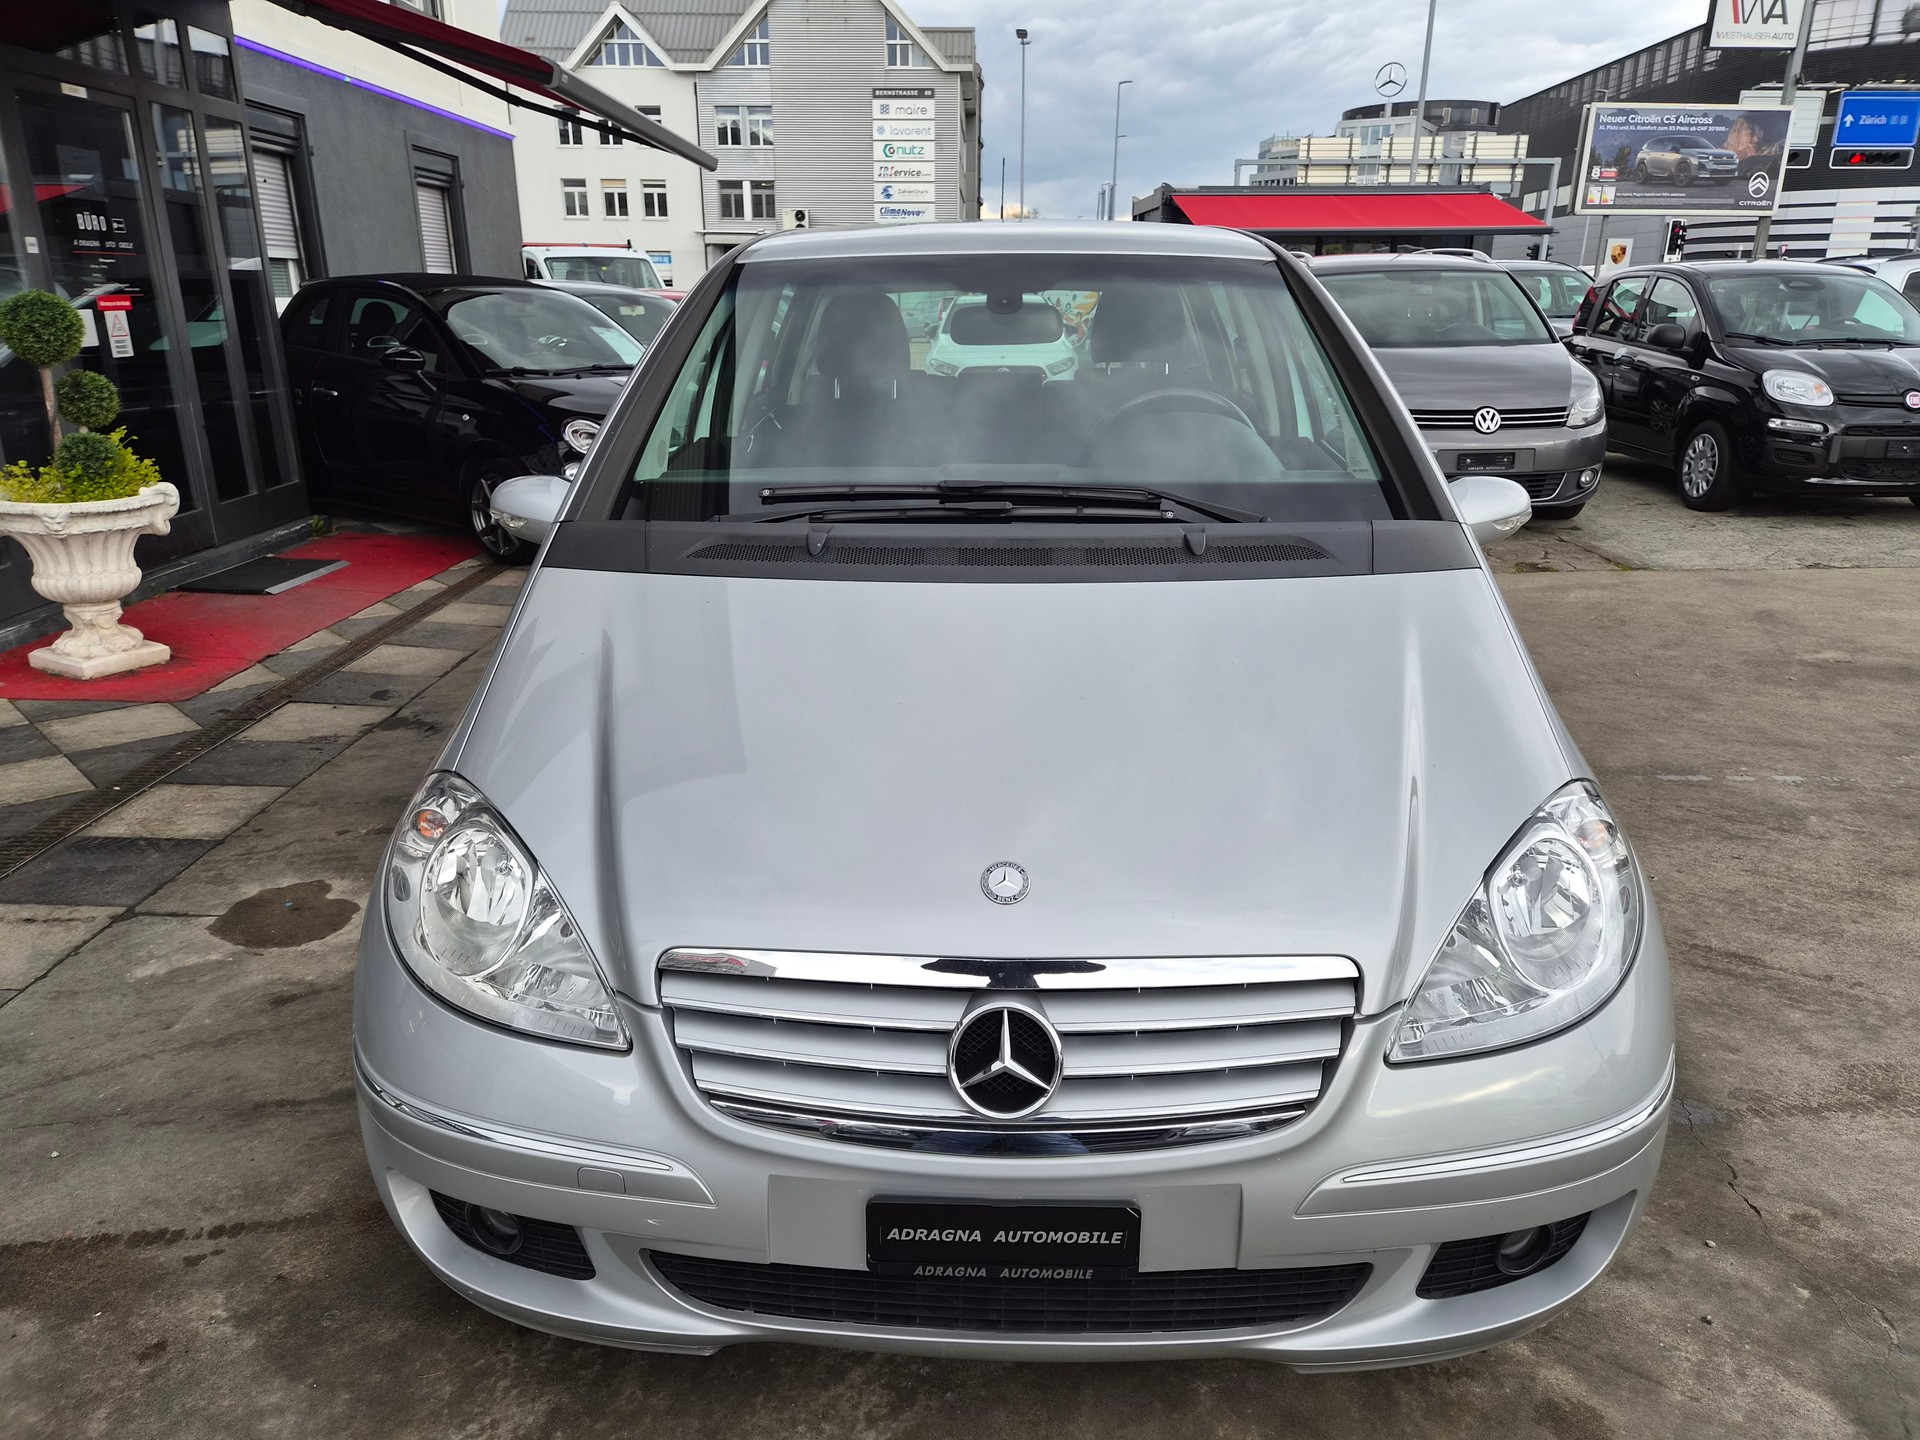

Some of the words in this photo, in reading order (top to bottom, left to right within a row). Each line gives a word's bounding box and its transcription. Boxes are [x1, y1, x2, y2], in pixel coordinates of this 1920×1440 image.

[1772, 32, 1794, 40] AUTO
[1600, 114, 1627, 123] Neuer
[1628, 114, 1661, 123] Citroën
[1663, 115, 1677, 124] C5
[1677, 115, 1714, 124] Aircross
[1859, 114, 1887, 124] Zürich
[76, 211, 107, 231] BÜRO
[887, 1228, 982, 1242] ADRAGNA
[993, 1230, 1123, 1244] AUTOMOBILE
[914, 1265, 987, 1278] ADRAGNA
[1000, 1267, 1094, 1280] AUTOMOBILE
